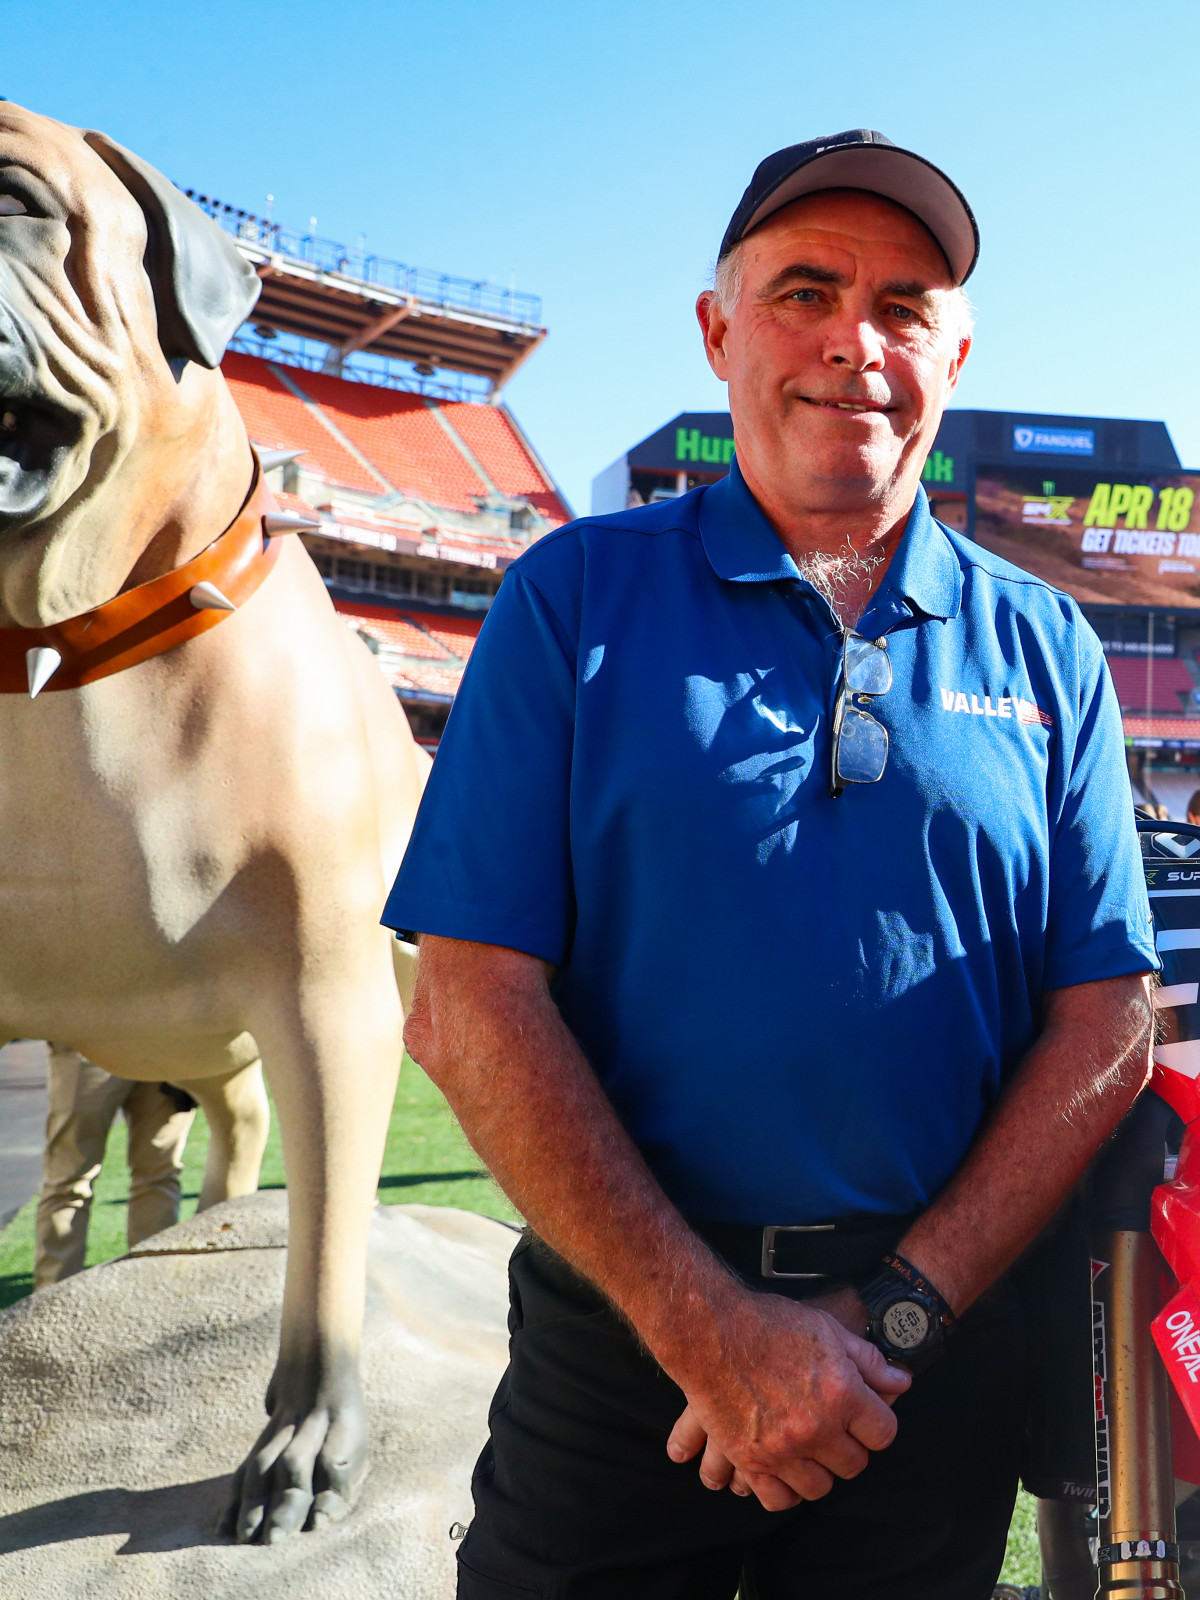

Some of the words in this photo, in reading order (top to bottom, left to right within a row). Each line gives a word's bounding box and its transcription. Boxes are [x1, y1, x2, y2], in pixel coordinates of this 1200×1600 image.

[1034, 433, 1093, 449] FANDUEL
[1083, 483, 1154, 529] APR
[1156, 487, 1194, 531] 18
[1081, 528, 1114, 553] GET
[1113, 529, 1177, 557] TICKETS
[940, 687, 1028, 724] VALLEY
